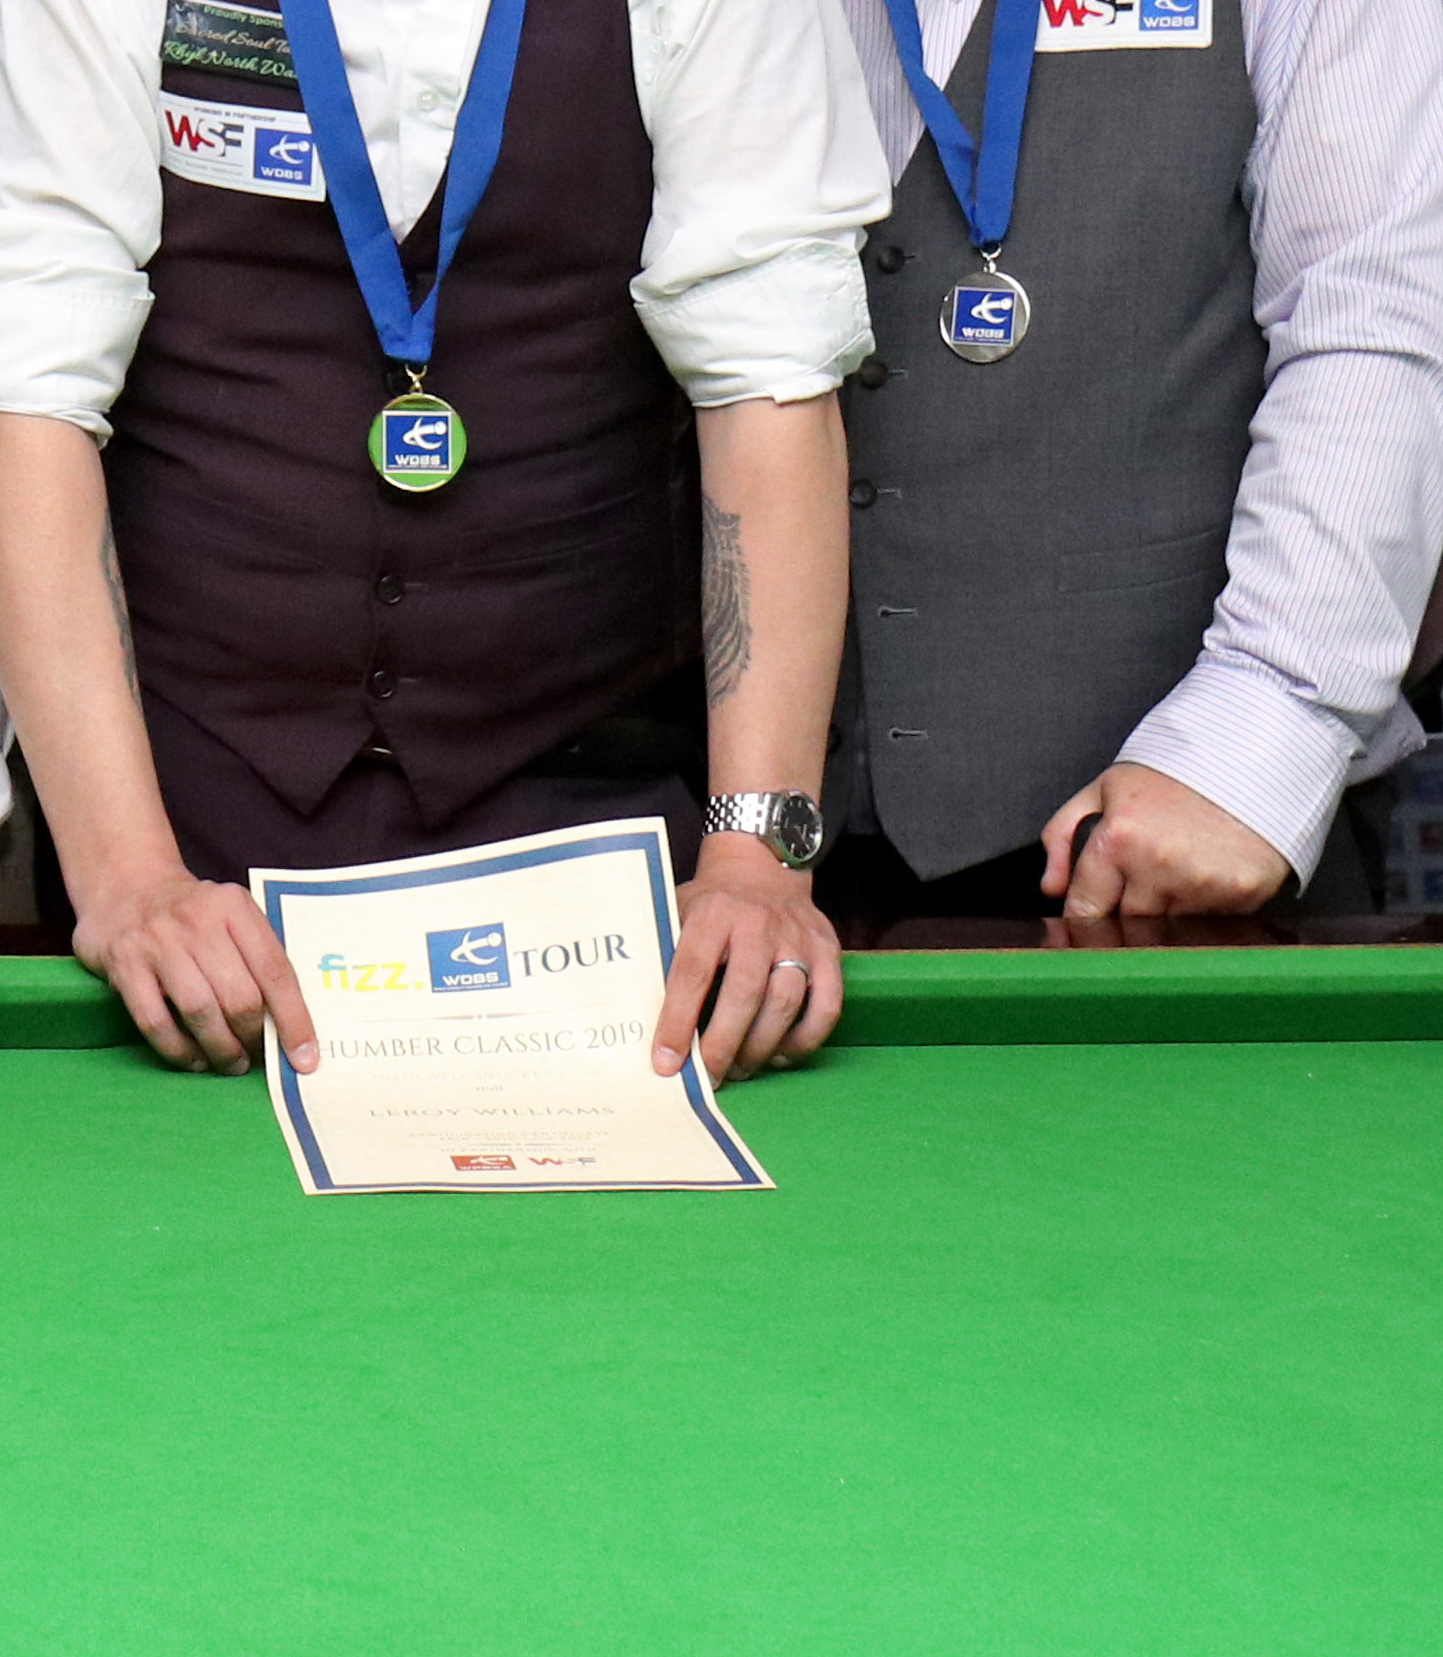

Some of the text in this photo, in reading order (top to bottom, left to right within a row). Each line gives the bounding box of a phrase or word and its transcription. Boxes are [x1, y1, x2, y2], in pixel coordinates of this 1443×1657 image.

[203, 5, 248, 22] Proudly
[1143, 16, 1196, 28] WDBS
[164, 40, 298, 78] Rhyl North Wa
[164, 109, 244, 156] WSF
[260, 166, 303, 180] WDBS
[318, 934, 632, 992] fizz. WDBS TOUR
[453, 1030, 574, 1054] CLASSIC
[579, 1020, 644, 1049] 2019
[369, 1107, 615, 1117] LEROY WILLIAMS
